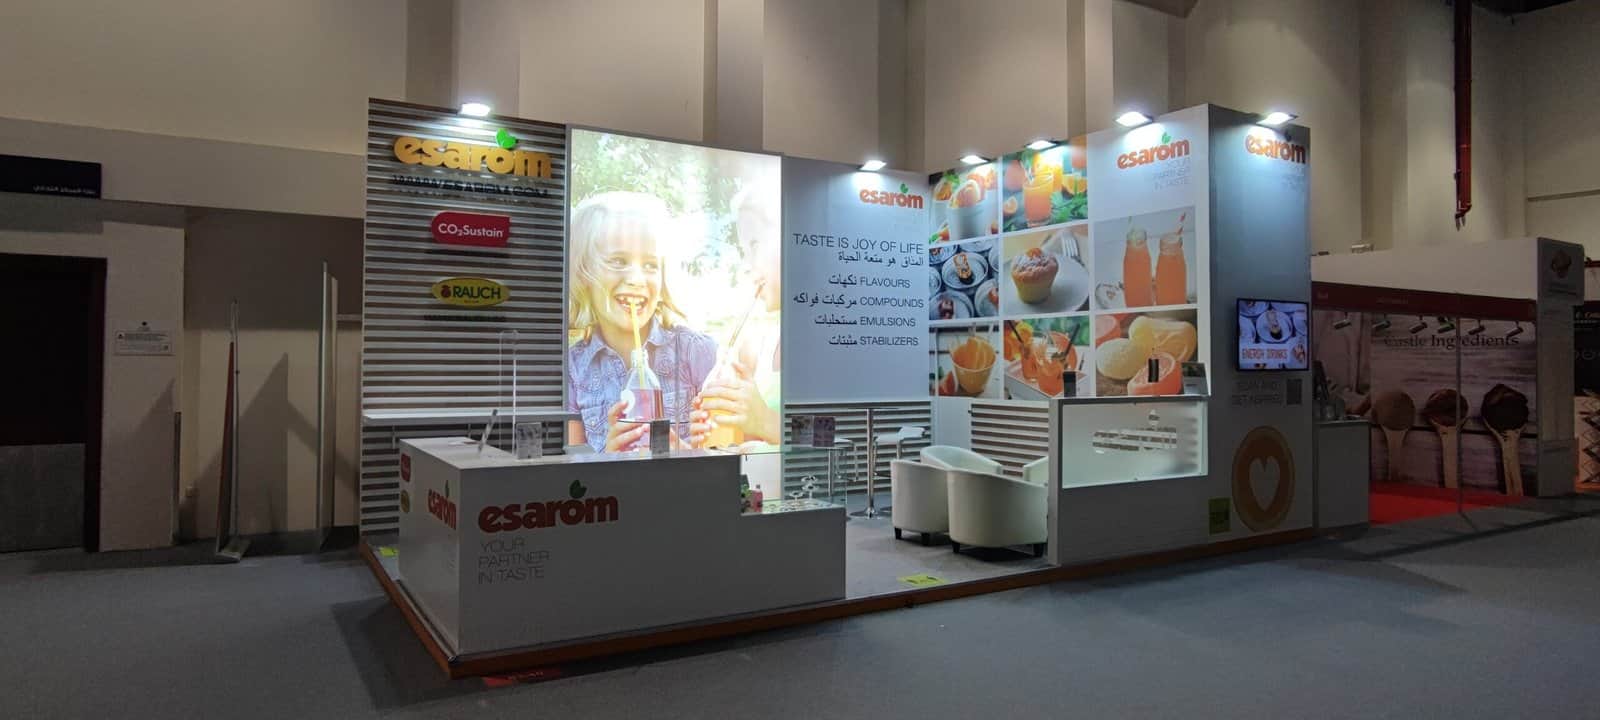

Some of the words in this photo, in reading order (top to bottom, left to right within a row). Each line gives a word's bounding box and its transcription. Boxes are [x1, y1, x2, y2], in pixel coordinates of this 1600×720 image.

[394, 135, 553, 179] esarom
[1117, 139, 1190, 169] esarom
[1245, 134, 1306, 164] esarom
[859, 189, 923, 209] esarom
[793, 233, 834, 248] TASTE
[838, 237, 849, 249] IS
[852, 238, 877, 250] JOY
[880, 241, 897, 252] OF
[900, 243, 925, 255] LIFE
[887, 256, 896, 267] هو
[860, 276, 911, 288] FLAVOURS
[452, 285, 501, 299] RAUCH
[860, 296, 925, 309] COMPOUNDS
[860, 316, 916, 327] EMULSIONS
[860, 336, 919, 346] STABILIZERS
[427, 488, 457, 530] esarom
[478, 495, 619, 533] esarom
[481, 536, 525, 552] YOUR
[478, 550, 550, 568] PARTNER
[478, 571, 493, 584] IN
[496, 566, 545, 581] TASTE
